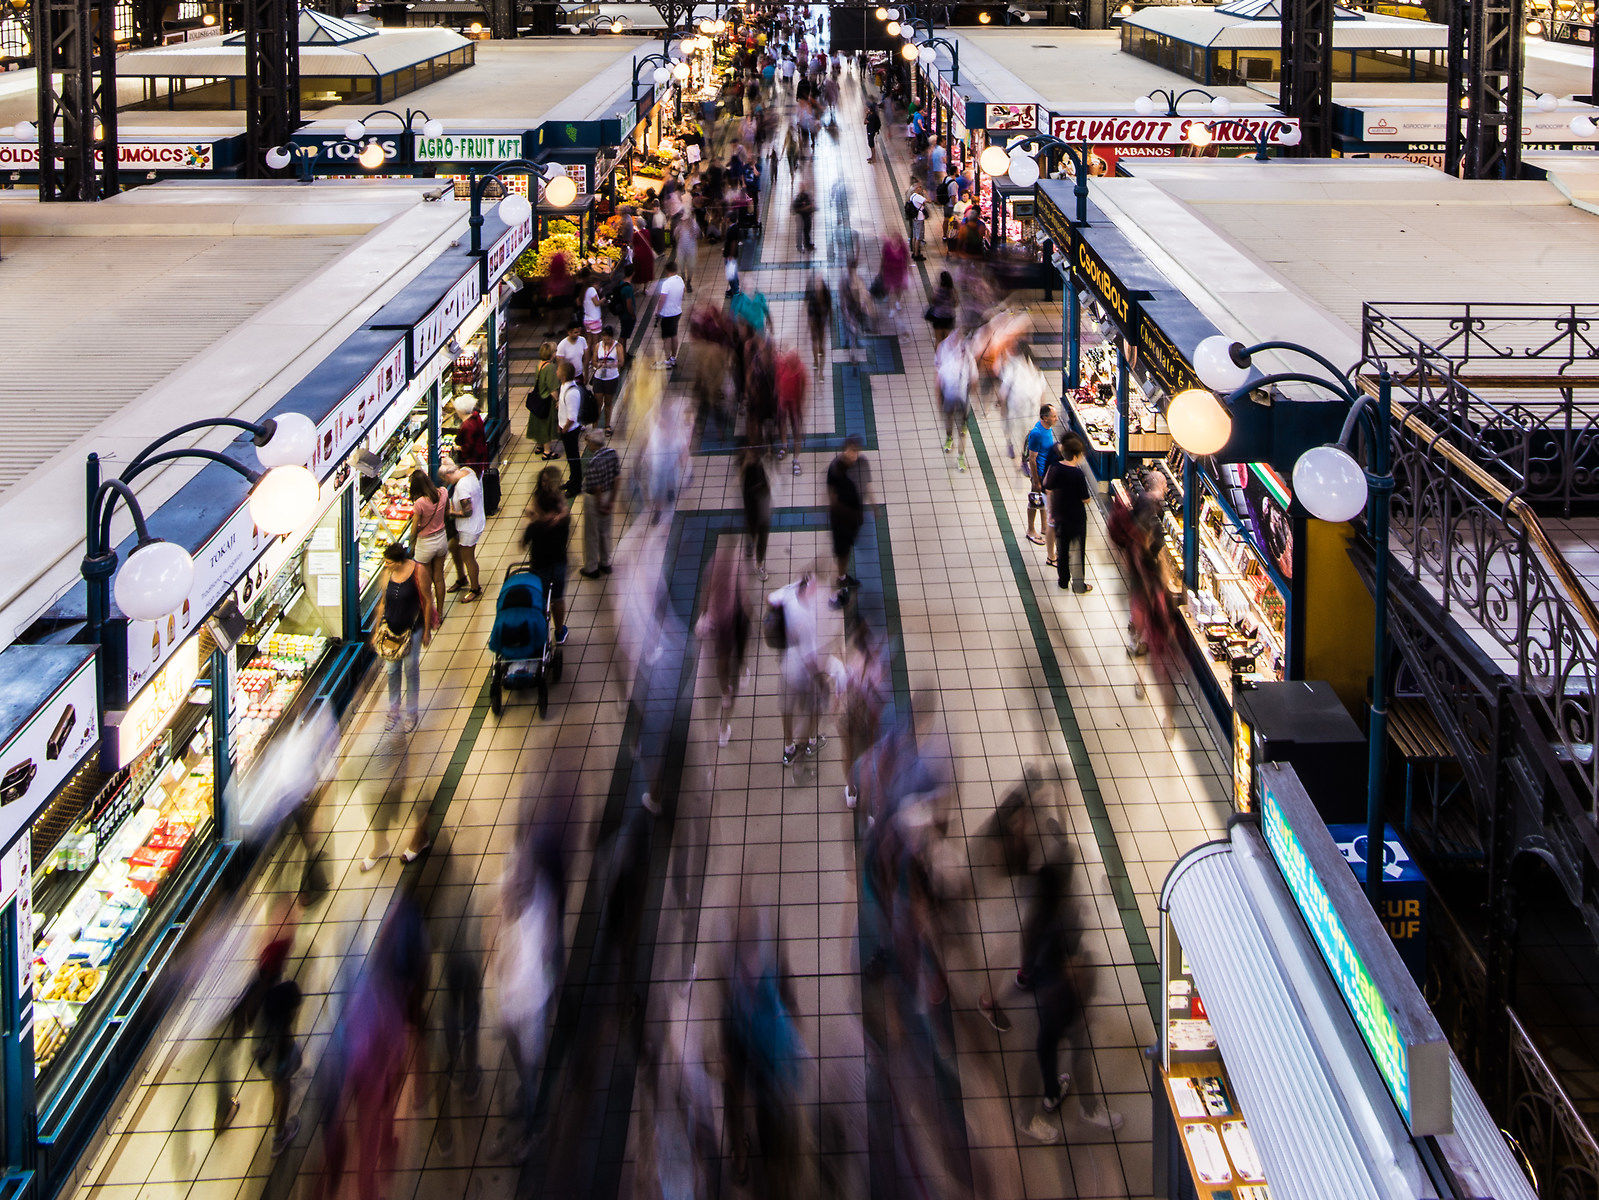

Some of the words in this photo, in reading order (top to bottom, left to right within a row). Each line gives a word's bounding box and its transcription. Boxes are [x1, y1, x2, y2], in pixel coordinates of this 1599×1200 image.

[1054, 118, 1172, 141] FELVÁGOTT
[1180, 118, 1298, 141] SAKÜZLE
[322, 137, 397, 159] TOJS
[418, 138, 495, 159] AGRO-FRUIT
[1114, 147, 1172, 157] KABANOS
